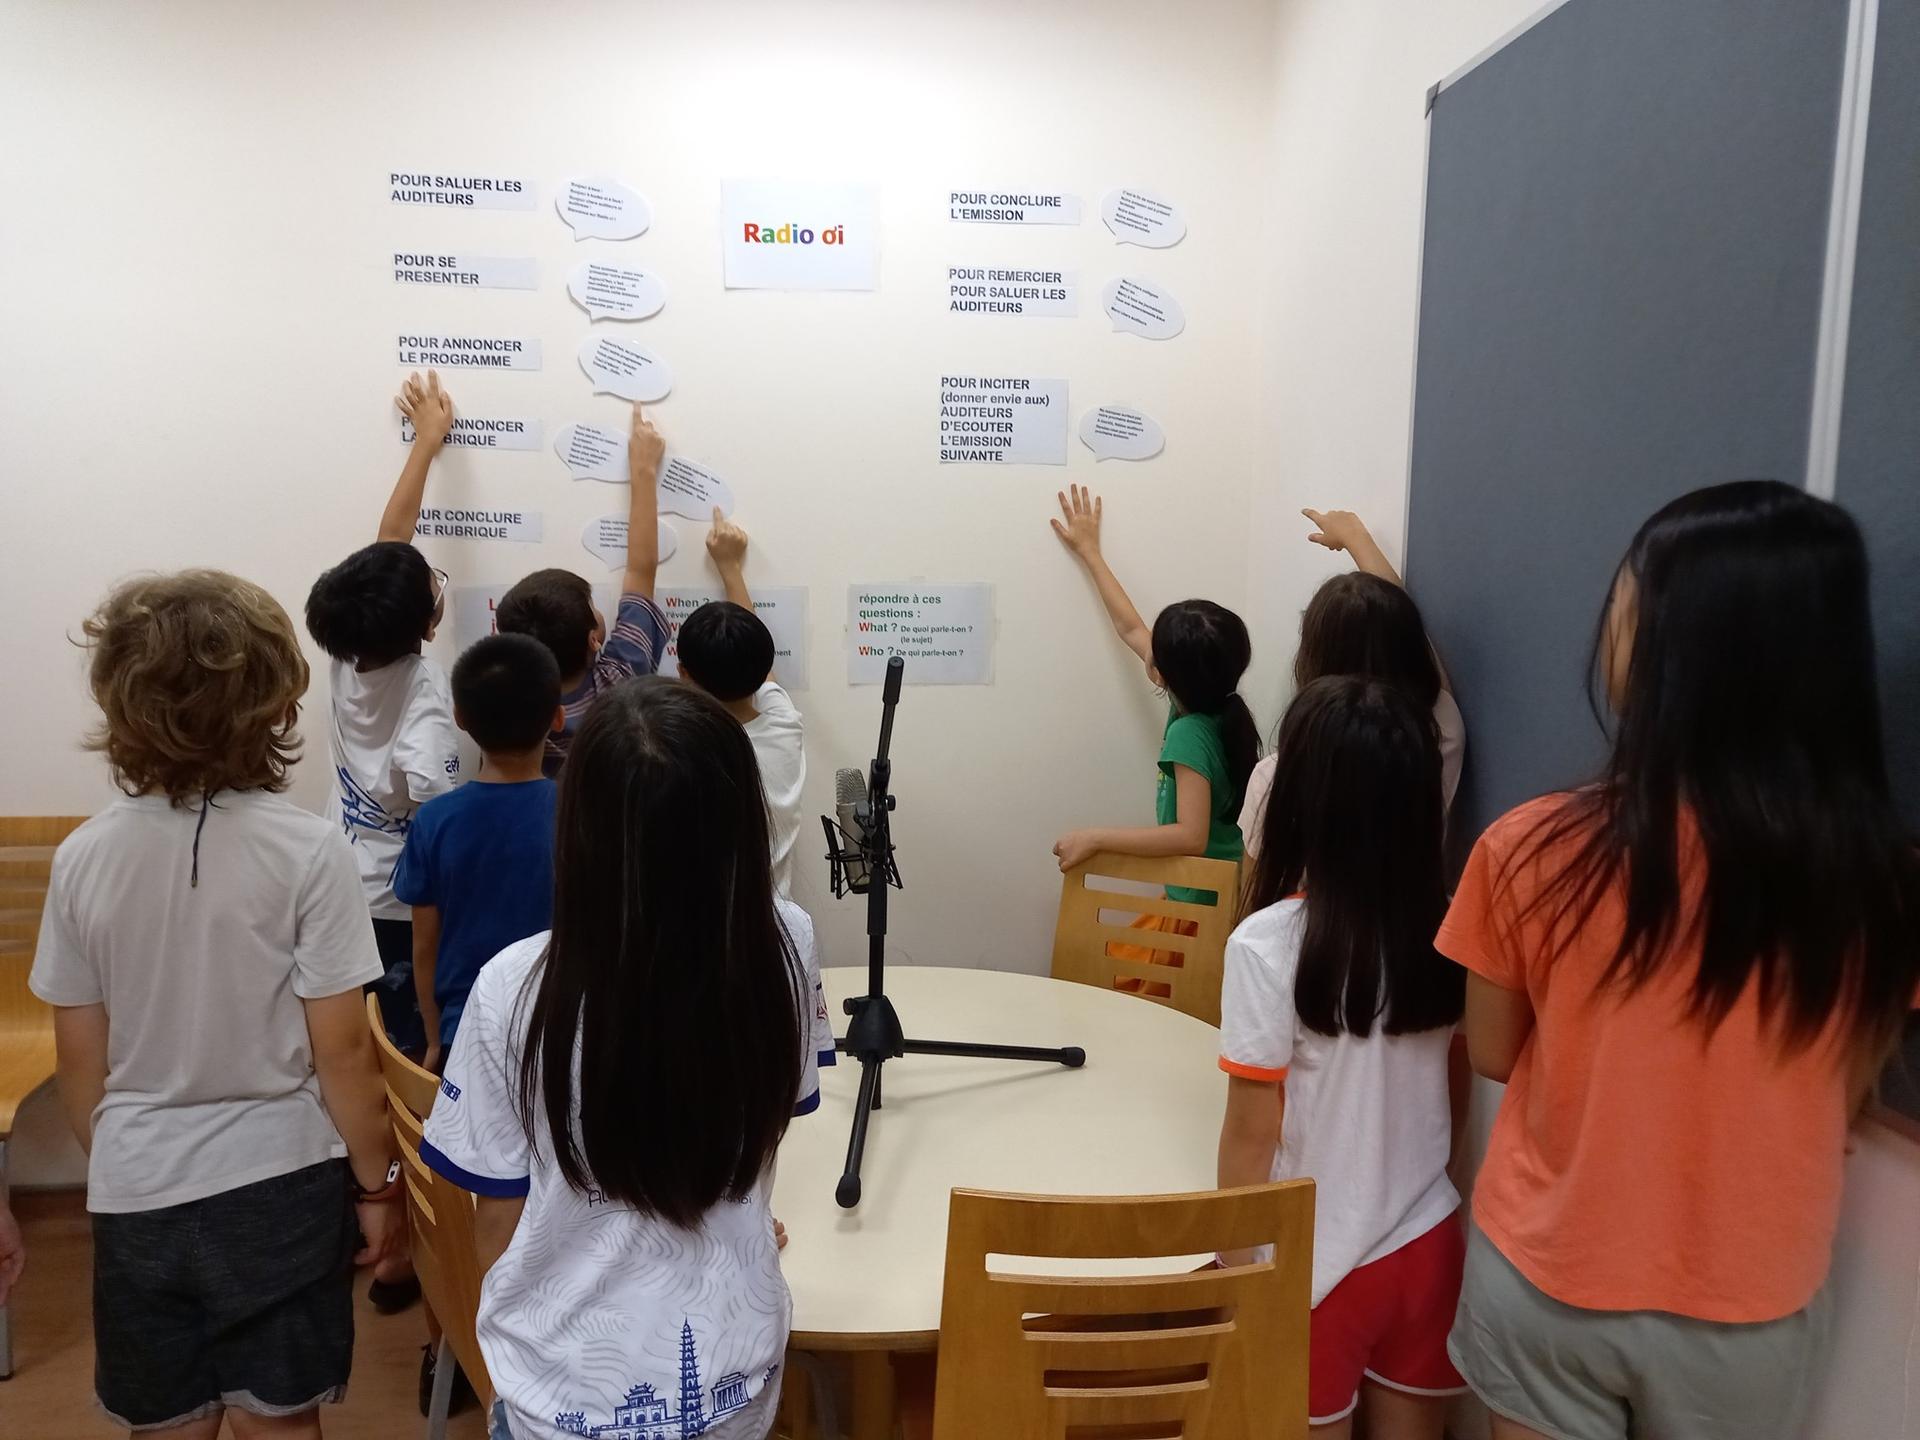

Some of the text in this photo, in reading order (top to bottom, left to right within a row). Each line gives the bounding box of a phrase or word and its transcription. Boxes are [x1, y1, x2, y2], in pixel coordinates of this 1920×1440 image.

[391, 174, 522, 192] POUR SALUER LES
[391, 190, 474, 205] AUDITEURS
[951, 193, 1061, 207] POUR CONCLURE
[951, 208, 1024, 221] L'EMISSION
[744, 223, 815, 244] Radio
[394, 254, 456, 268] POUR SE
[395, 270, 479, 284] PRESENTER
[949, 268, 1062, 283] POUR REMERCIER
[950, 285, 1066, 300] POUR SALUER LES
[950, 300, 1023, 313] AUDITEURS
[399, 336, 522, 352] POUR ANNONCER
[399, 352, 511, 366] LE PROGRAMME
[941, 377, 1030, 390] POUR INCITER
[941, 392, 1050, 407] (donner envie aux)
[941, 406, 1013, 418] AUDITEURS
[451, 418, 524, 433] NNONCER
[941, 421, 1013, 433] D'ECOUTER
[443, 434, 496, 446] BRIQUE
[941, 435, 1012, 447] L'EMISSION
[940, 450, 1003, 461] SUIVANTE
[419, 509, 522, 524] UR CONCLURE
[415, 524, 508, 538] NE RUBRIQUE
[666, 598, 699, 608] When
[859, 594, 941, 605] répondre à ces
[859, 608, 914, 620] questions
[859, 622, 888, 632] What
[912, 625, 929, 634] quoi
[931, 625, 966, 634] parle-t-on
[900, 636, 933, 644] (le sujet)
[859, 646, 884, 656] Who
[908, 649, 920, 657] qui
[921, 649, 957, 657] parle-t-on
